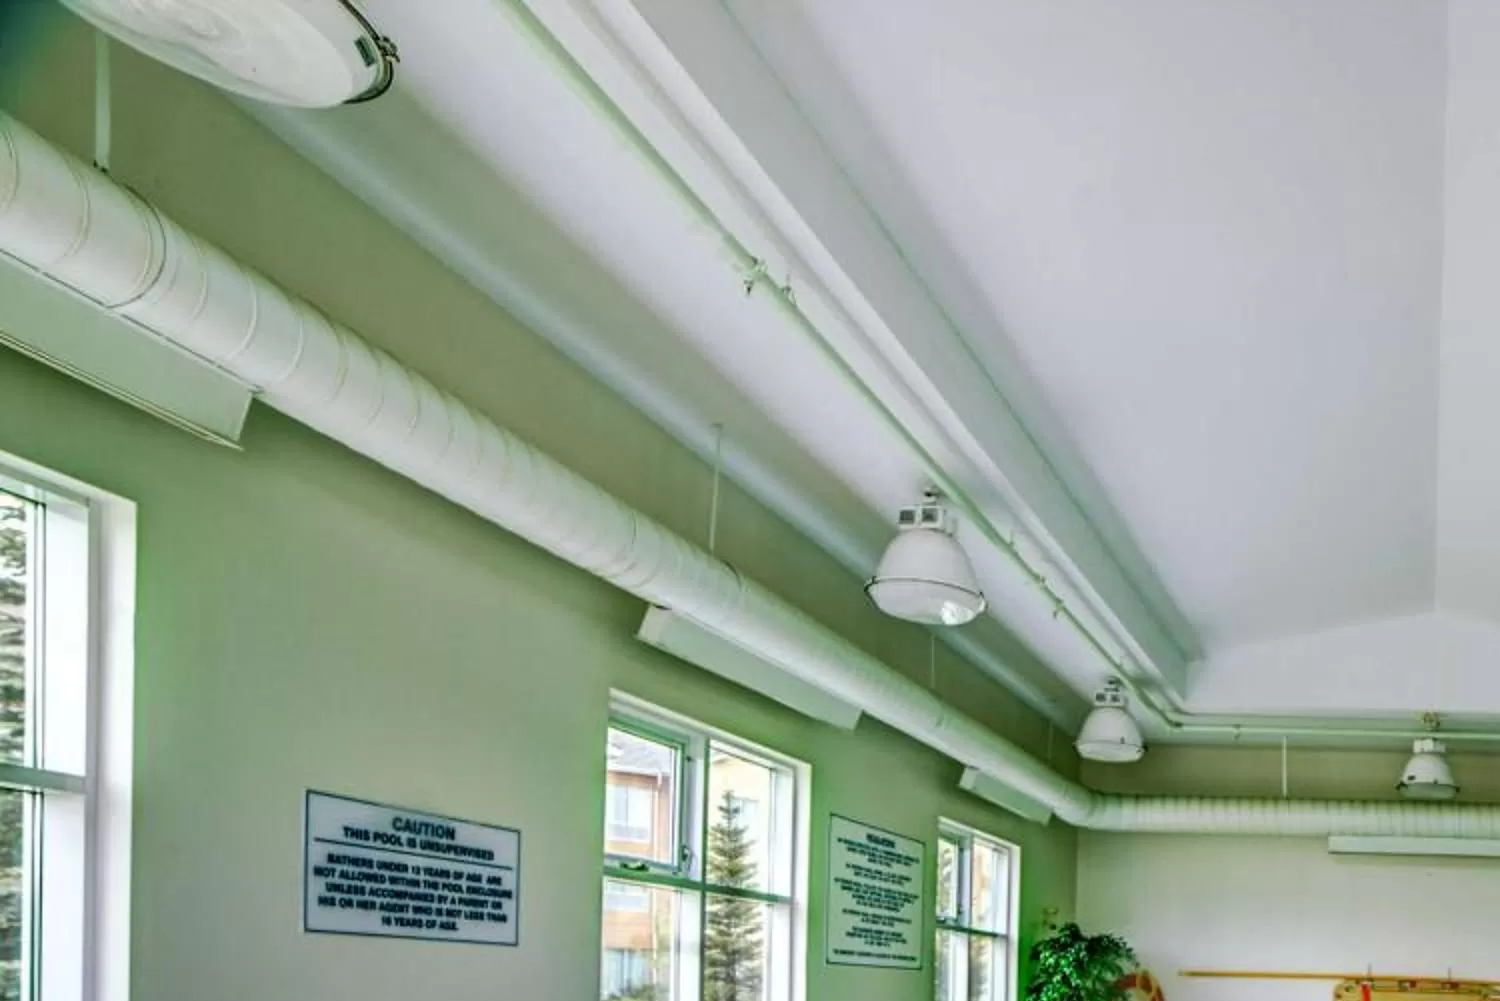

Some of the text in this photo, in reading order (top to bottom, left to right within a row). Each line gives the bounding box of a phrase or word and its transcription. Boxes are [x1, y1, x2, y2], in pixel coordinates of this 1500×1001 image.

[391, 817, 455, 840] CAUTION
[342, 827, 494, 861] THIS POOL IS UNSUPERVISED
[313, 866, 335, 877] NOT
[338, 869, 385, 883] ALLOWED
[388, 876, 420, 888] WITHIN
[423, 880, 438, 890] THE
[442, 883, 463, 893] POOL
[376, 860, 408, 873] UNDER
[423, 867, 450, 879] YEARS
[453, 871, 463, 881] OF
[486, 876, 501, 886] ARE
[325, 882, 365, 895] UNLESS
[368, 887, 434, 903] ACCOMPANIED
[437, 896, 448, 904] BY
[450, 897, 456, 905] A
[458, 898, 488, 909] PARENT
[338, 898, 353, 908] OR
[356, 900, 376, 910] HER
[445, 909, 461, 918] NOT
[464, 911, 483, 920] LESS
[394, 917, 422, 928] YEARS
[426, 920, 435, 929] OF
